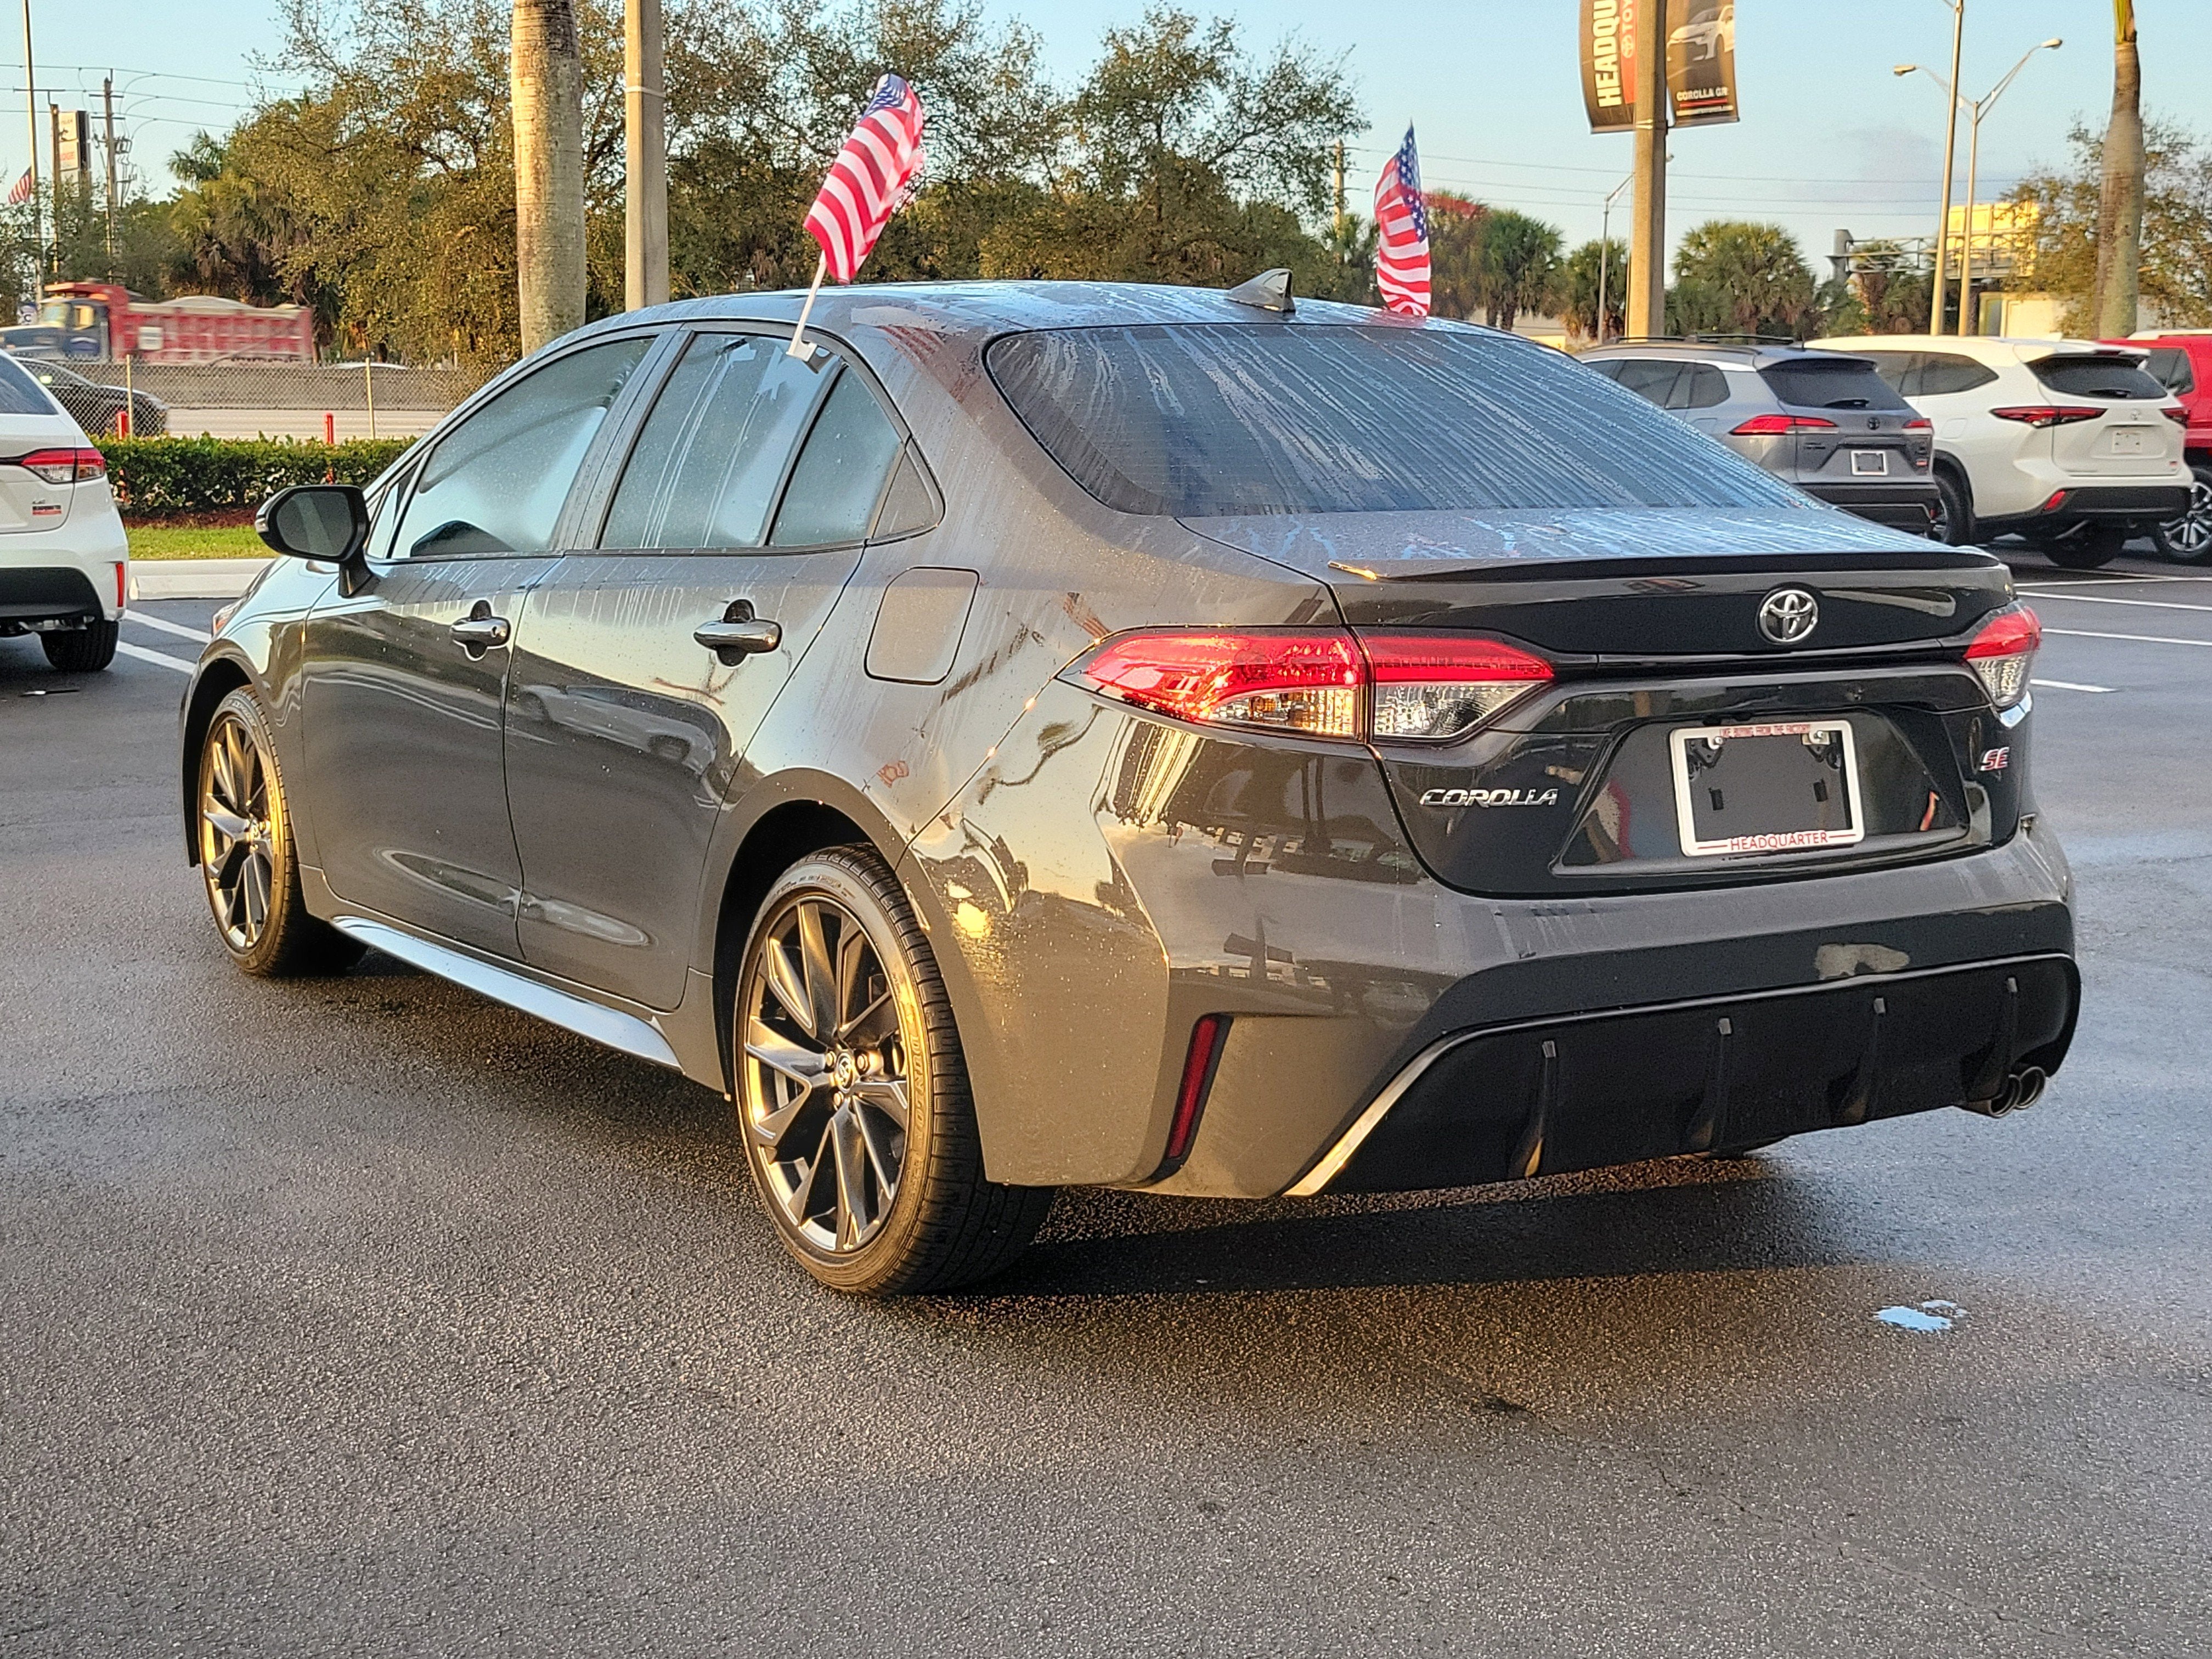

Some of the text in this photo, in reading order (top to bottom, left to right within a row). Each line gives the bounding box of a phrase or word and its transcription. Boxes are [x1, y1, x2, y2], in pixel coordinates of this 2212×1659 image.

[1593, 0, 1622, 107] HEADQU
[1676, 88, 1714, 101] COROLLA
[1980, 747, 2010, 771] SE
[1419, 789, 1559, 808] COROLLA
[1730, 832, 1828, 850] HEADQUARTER
